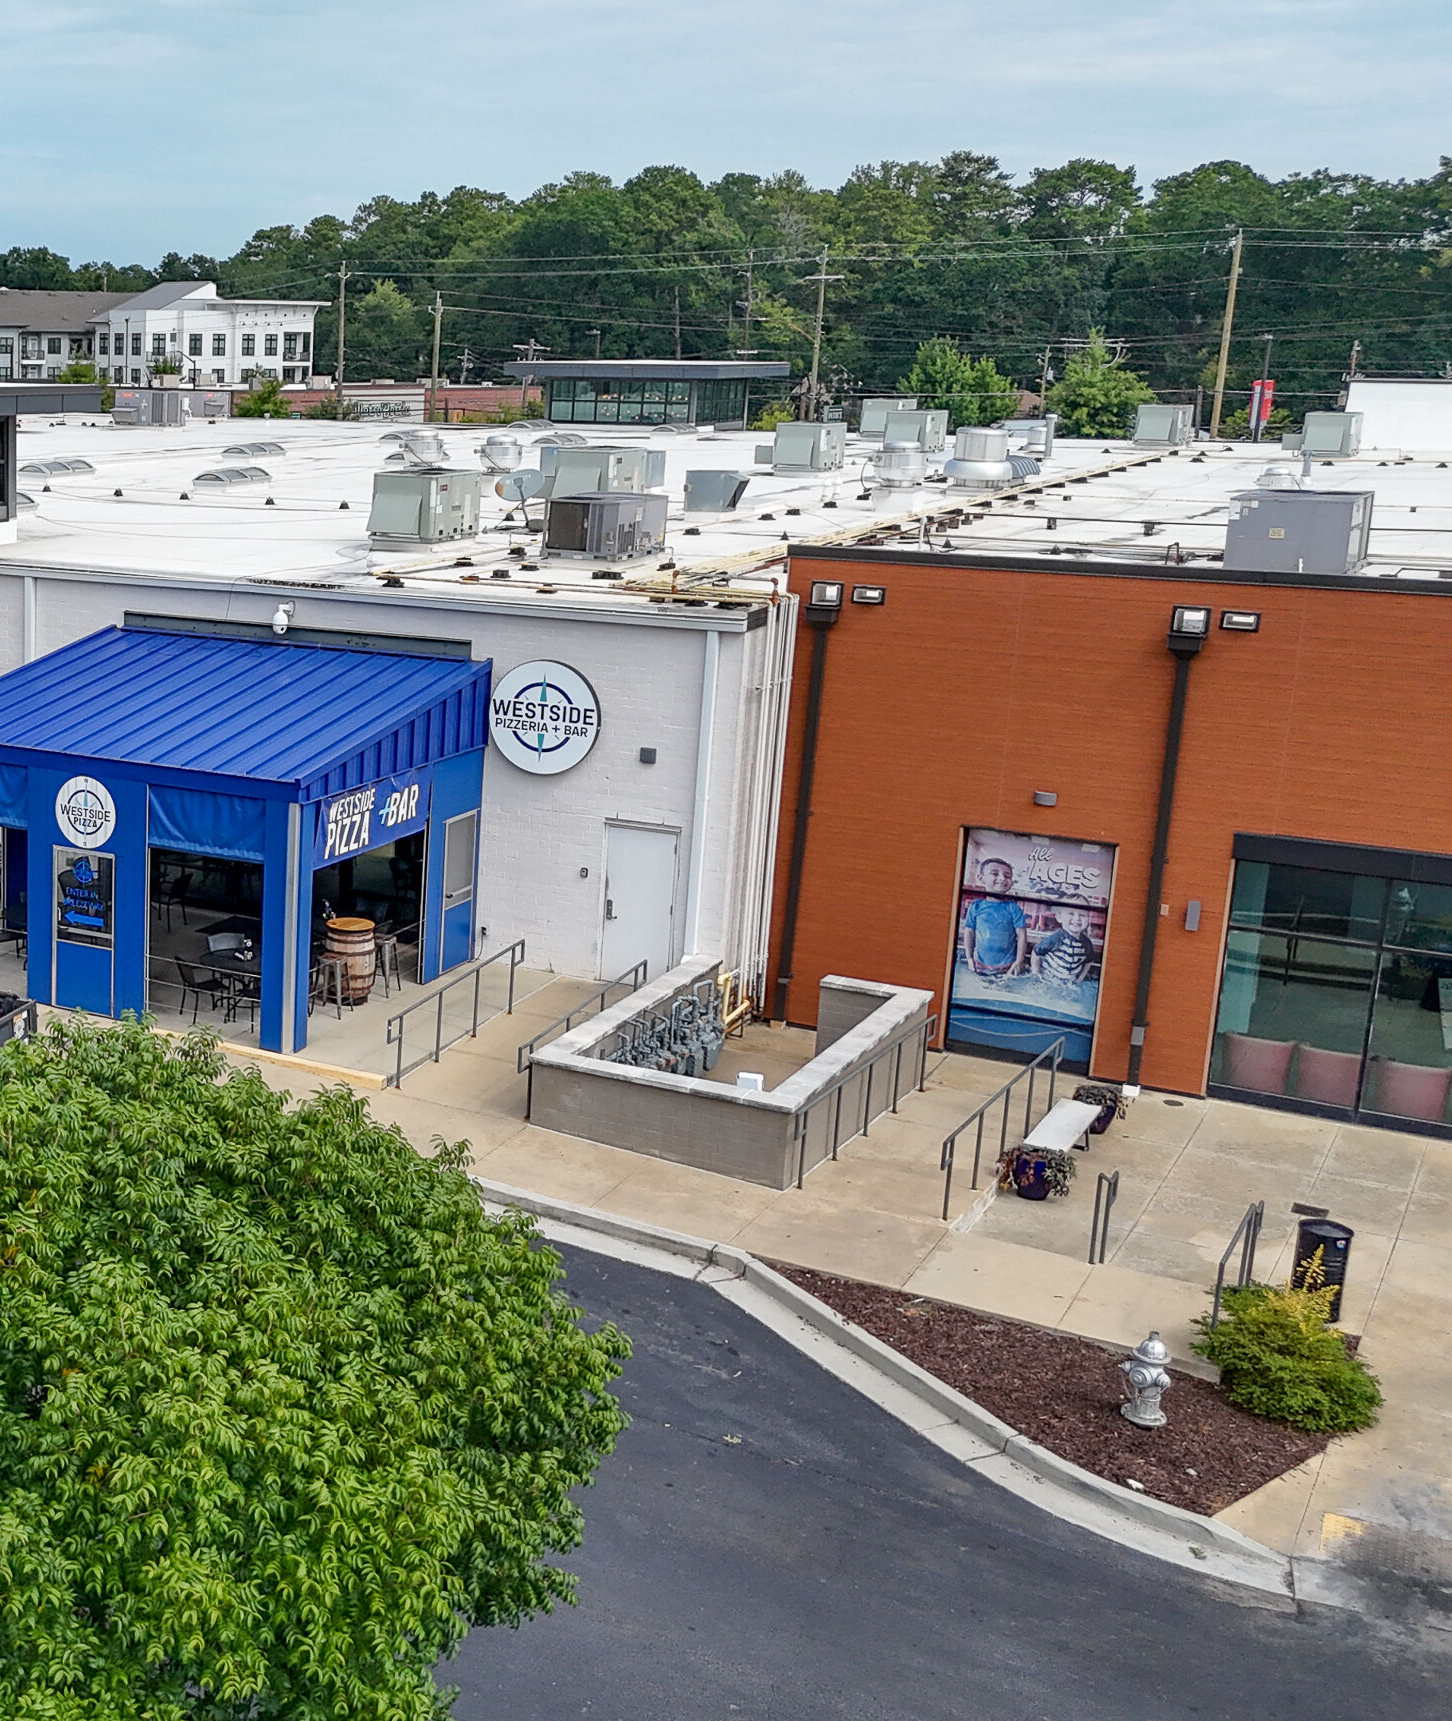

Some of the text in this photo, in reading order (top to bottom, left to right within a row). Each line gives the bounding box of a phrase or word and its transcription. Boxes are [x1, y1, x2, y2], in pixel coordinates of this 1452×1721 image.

[493, 698, 595, 726] WESTSIDE
[495, 717, 588, 737] PIZZERIA + BAR
[60, 803, 111, 822] WESTSIDE
[329, 787, 376, 823] WESTSIDE
[73, 817, 98, 828] PIZZA
[324, 811, 371, 860] PIZZA
[1028, 847, 1054, 862] All
[1029, 860, 1100, 888] AGES
[66, 886, 89, 898] ENTER
